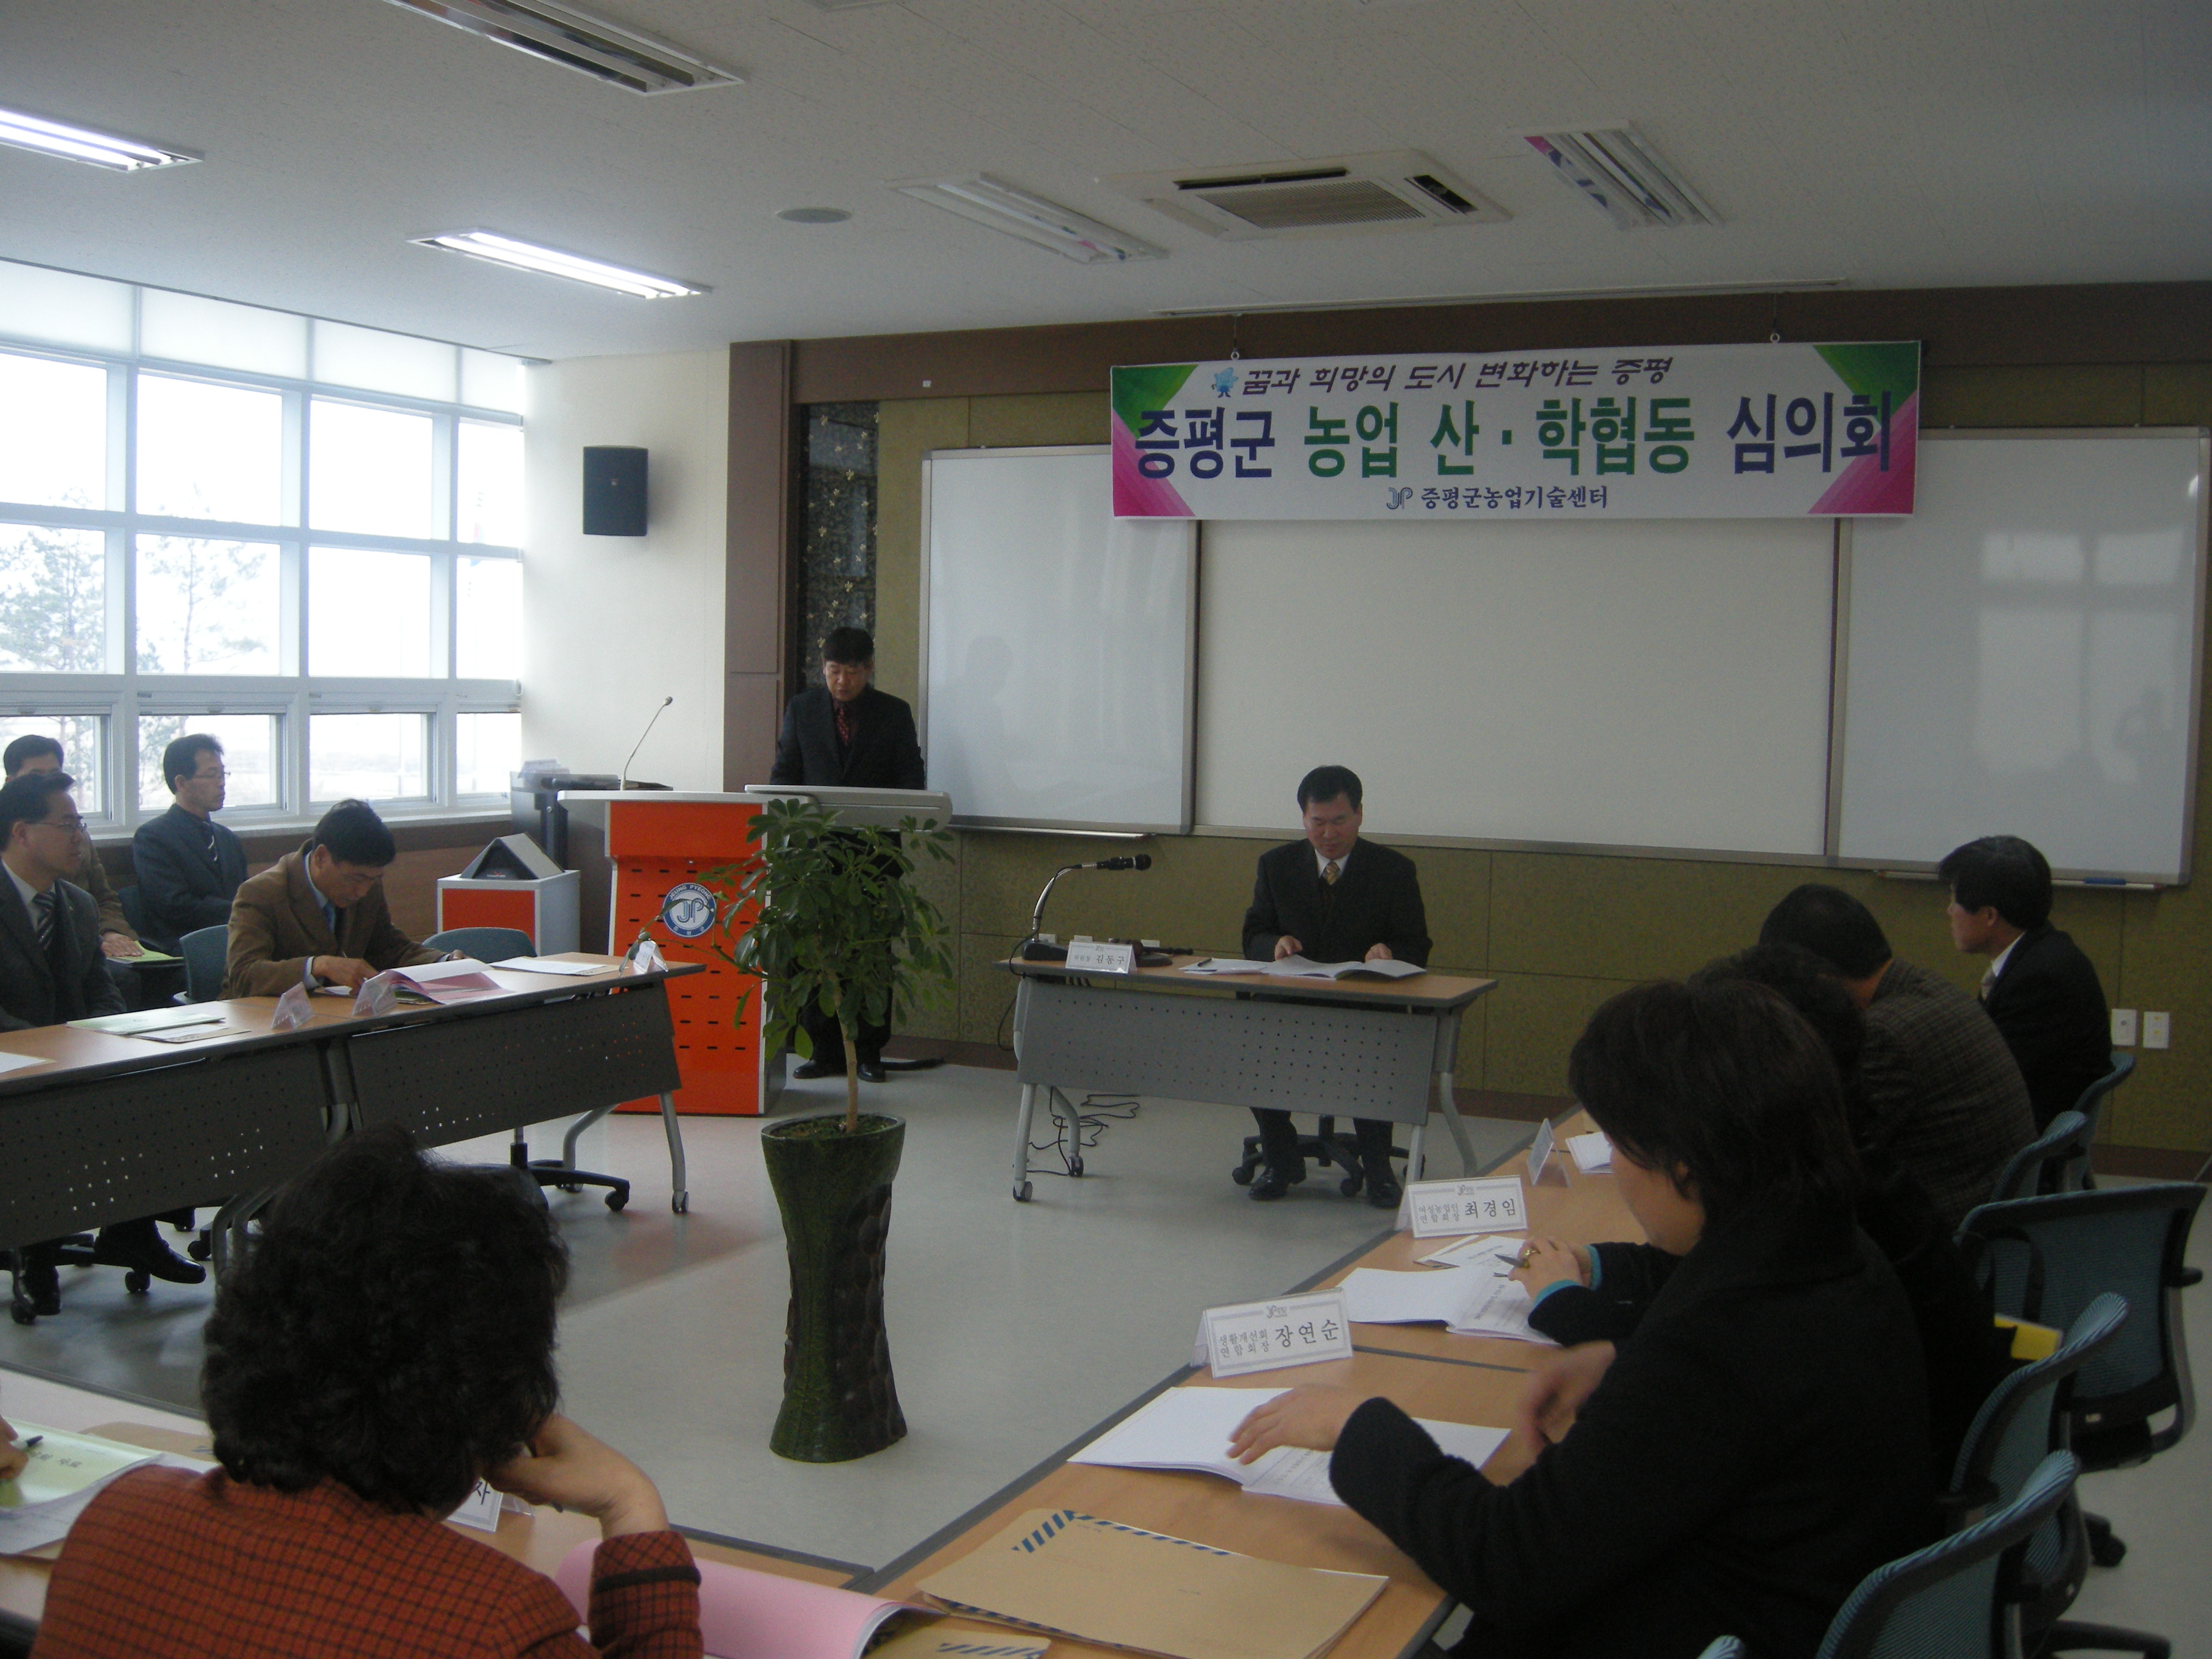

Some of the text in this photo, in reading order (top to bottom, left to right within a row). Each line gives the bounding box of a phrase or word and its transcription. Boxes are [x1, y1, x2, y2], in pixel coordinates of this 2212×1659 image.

[1242, 356, 1674, 395] 꿈과 희망의 도시 변화하는 증평
[1135, 406, 1275, 479] 증평군
[1304, 401, 1399, 478] 농업
[1726, 390, 1892, 474] 심의회
[1420, 485, 1608, 510] 증평군농업기술센터
[669, 884, 711, 900] JEUNG PYEONG
[1096, 954, 1125, 965] 김동구
[1465, 1198, 1516, 1219] 최경임
[1219, 1328, 1268, 1347] 생활개선회
[1275, 1319, 1339, 1348] 장연순
[1220, 1340, 1270, 1358] 연합회장
